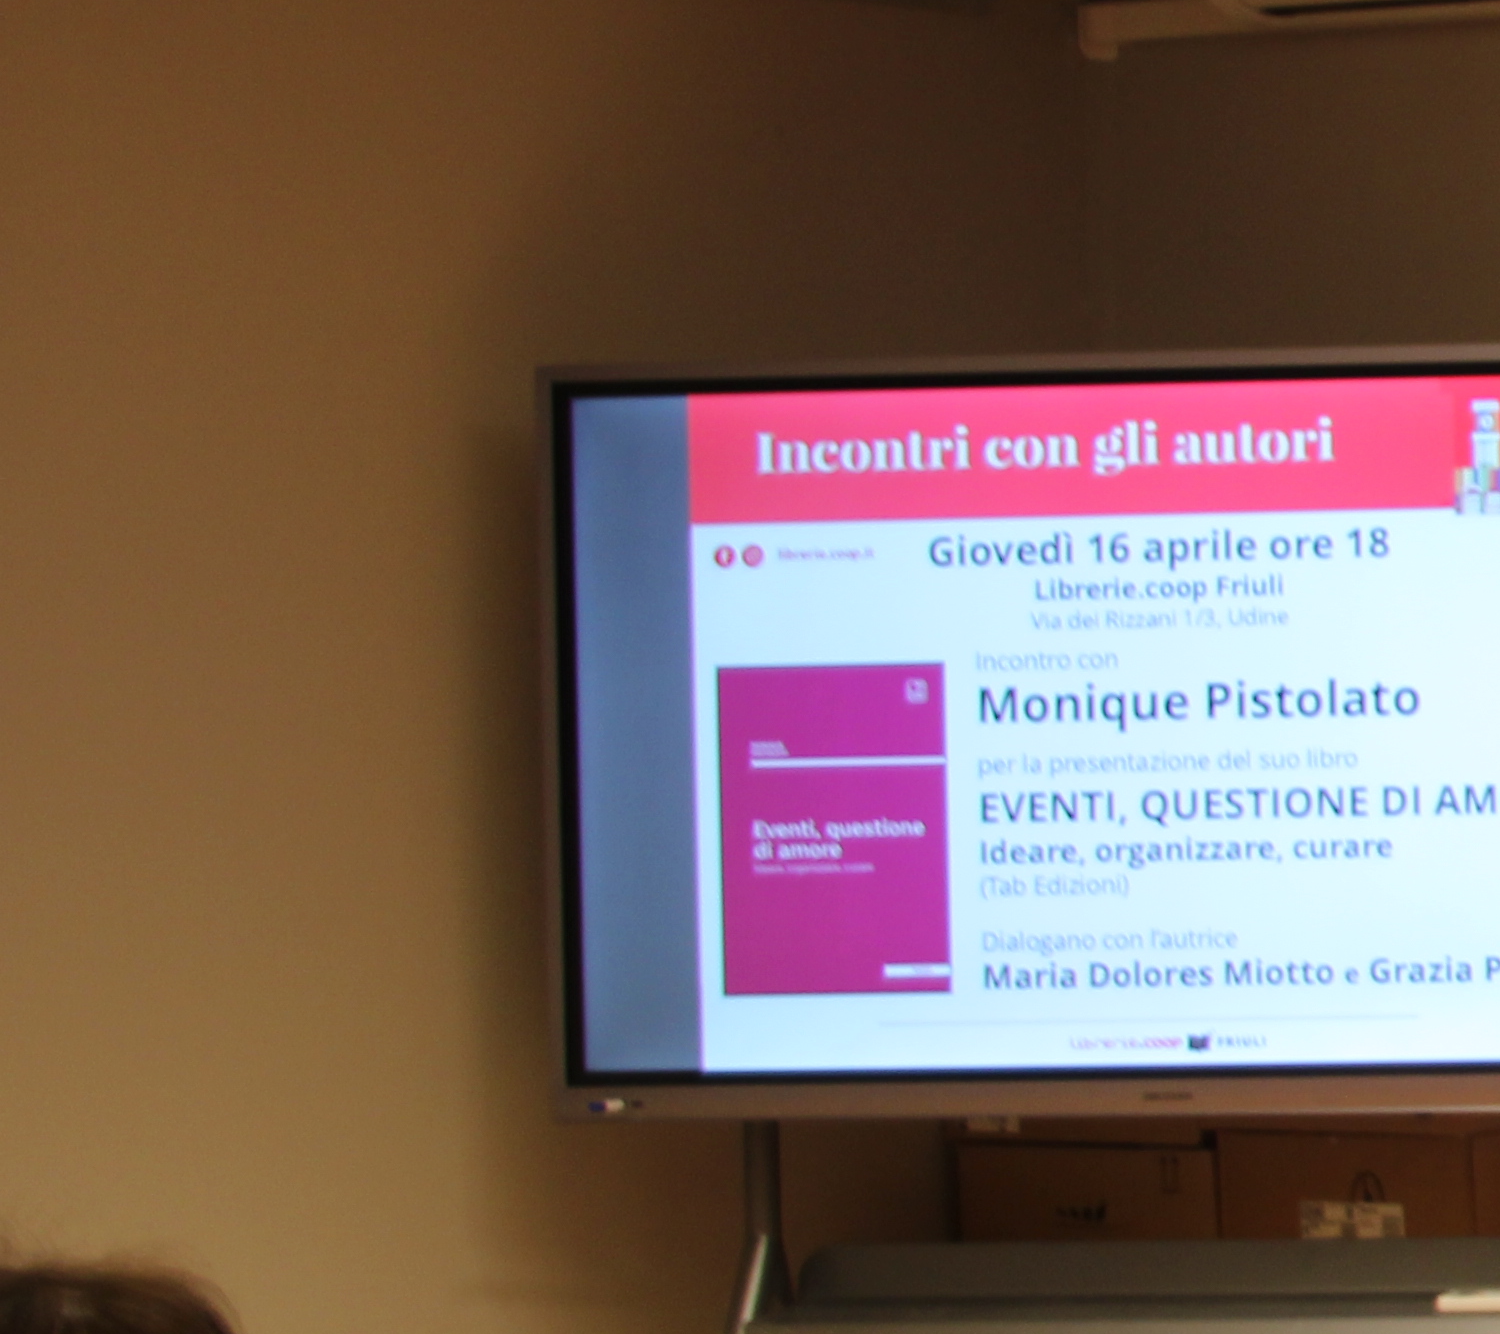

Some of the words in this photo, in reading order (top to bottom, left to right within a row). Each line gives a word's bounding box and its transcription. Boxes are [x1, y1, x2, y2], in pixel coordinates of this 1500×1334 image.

[756, 423, 973, 475] Incontri
[982, 431, 1080, 470] con
[1092, 419, 1158, 476] gli
[1171, 415, 1335, 465] autori
[928, 531, 1074, 567] Giovedì
[1089, 532, 1131, 563] 16
[1143, 527, 1258, 571] aprile
[1269, 537, 1334, 560] ore
[1346, 526, 1391, 558] 18
[1034, 575, 1209, 603] Librerie.coop
[1216, 572, 1285, 597] Friuli
[1030, 611, 1063, 631] Via
[1068, 609, 1101, 630] dei
[1105, 608, 1178, 629] Rizzani
[1184, 607, 1223, 631] 1/3,
[1228, 604, 1289, 626] Udine
[974, 649, 1073, 671] Incontro
[1079, 652, 1119, 669] con
[977, 681, 1190, 734] Monique
[1206, 676, 1422, 720] Pistolato
[977, 756, 1022, 777] per
[1024, 751, 1044, 774] la
[1049, 747, 1210, 777] presentazione
[1216, 749, 1253, 770] del
[1258, 752, 1301, 769] suo
[1306, 747, 1359, 768] libro
[980, 789, 1128, 828] EVENTI,
[1140, 785, 1369, 827] QUESTIONE
[1382, 784, 1422, 816] DI
[979, 839, 1087, 867] Ideare,
[1095, 833, 1284, 870] organizzare,
[1292, 836, 1394, 860] curare
[979, 875, 1027, 900] (Tab
[1034, 873, 1131, 898] Edizioni)
[981, 931, 1097, 957] Dialogano
[1102, 933, 1145, 950] con
[982, 961, 1077, 989] Maria
[1089, 959, 1214, 988] Dolores
[1223, 955, 1335, 986] Miotto
[1344, 967, 1360, 984] e
[1370, 954, 1473, 984] Grazia
